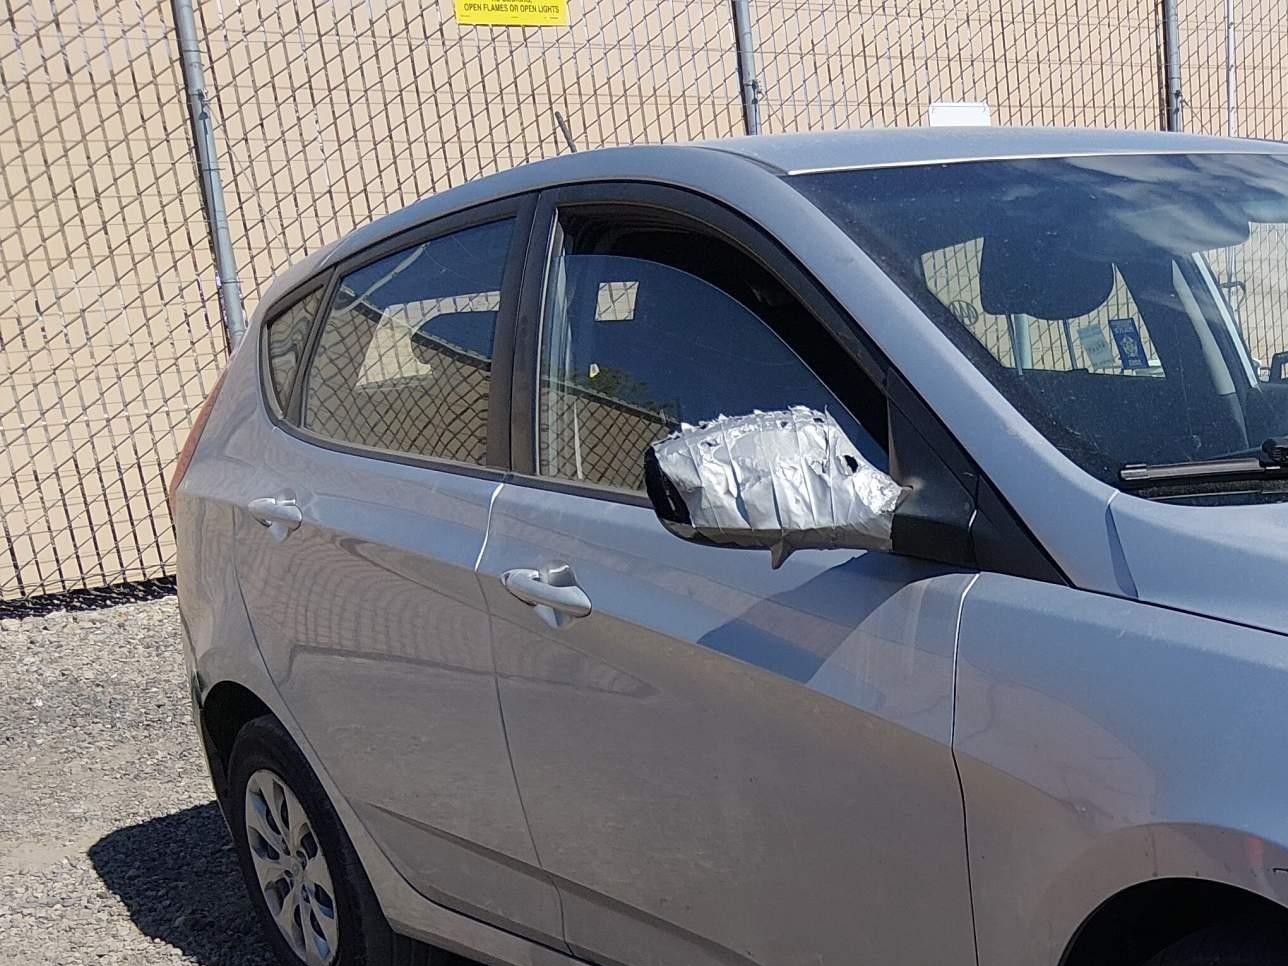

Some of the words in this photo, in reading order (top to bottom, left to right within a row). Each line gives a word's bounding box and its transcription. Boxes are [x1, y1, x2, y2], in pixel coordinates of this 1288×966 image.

[463, 3, 482, 11] OPEN
[483, 3, 508, 12] FLAMES
[509, 4, 519, 12] OR
[520, 5, 537, 13] OPEN
[538, 5, 560, 13] LIGHTS
